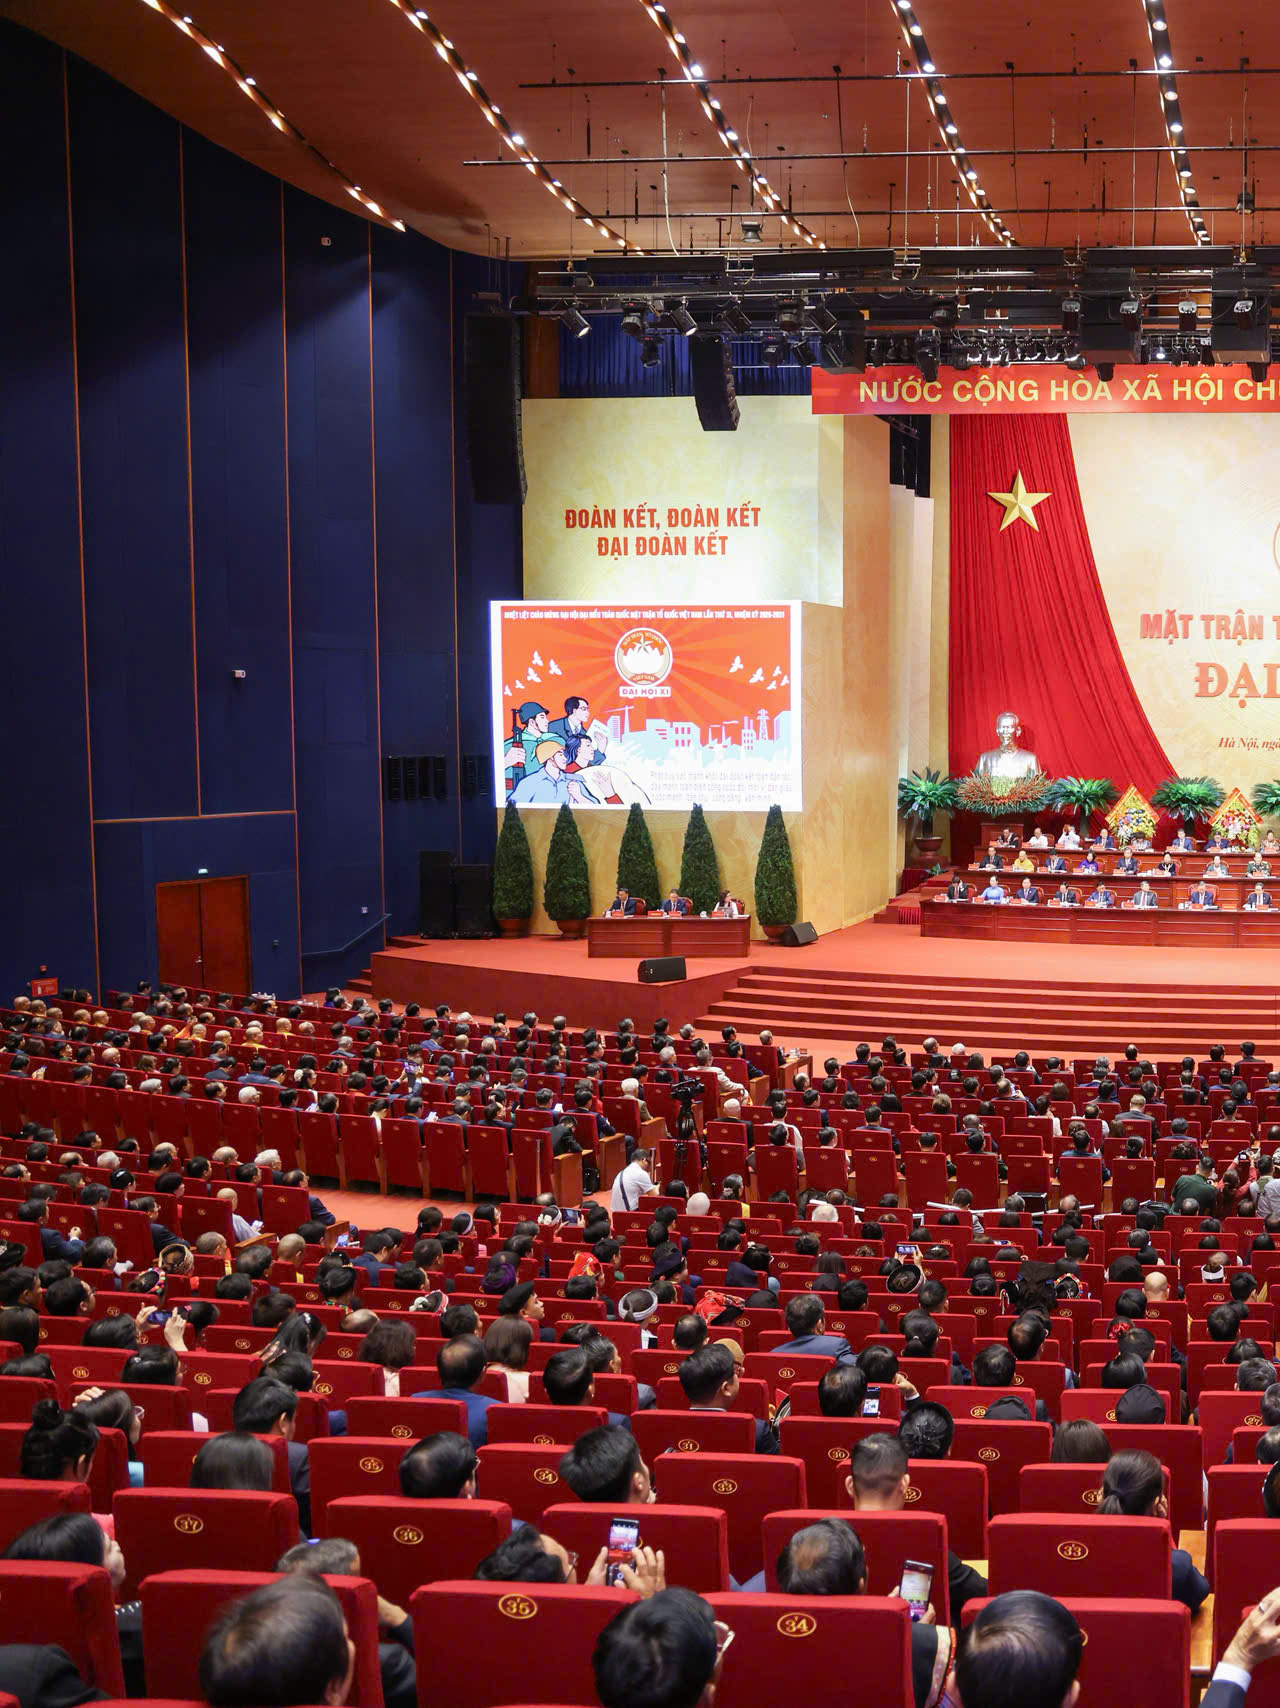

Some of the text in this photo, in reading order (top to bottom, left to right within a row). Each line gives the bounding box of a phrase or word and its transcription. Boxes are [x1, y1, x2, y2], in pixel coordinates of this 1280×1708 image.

[860, 376, 942, 402] NƯỚC
[953, 375, 1038, 406] CỘNG
[1050, 374, 1113, 401] HÒA
[1122, 374, 1162, 400] XÃ
[1173, 374, 1222, 405] HỘI
[565, 501, 761, 530] ĐOÀN KẾT, ĐOÀN KẾT
[597, 530, 728, 560] ĐẠI ĐOÀN KẾT
[1140, 608, 1193, 645] MẶT
[1201, 608, 1264, 646] TRẬN
[1195, 662, 1280, 708] ĐẠI
[1218, 737, 1235, 748] Hà
[1239, 737, 1259, 750] Nội,
[180, 1519, 198, 1531] 37
[399, 1530, 418, 1541] 36
[1063, 1545, 1082, 1557] 33
[506, 1599, 530, 1614] 35
[785, 1617, 809, 1632] 34
